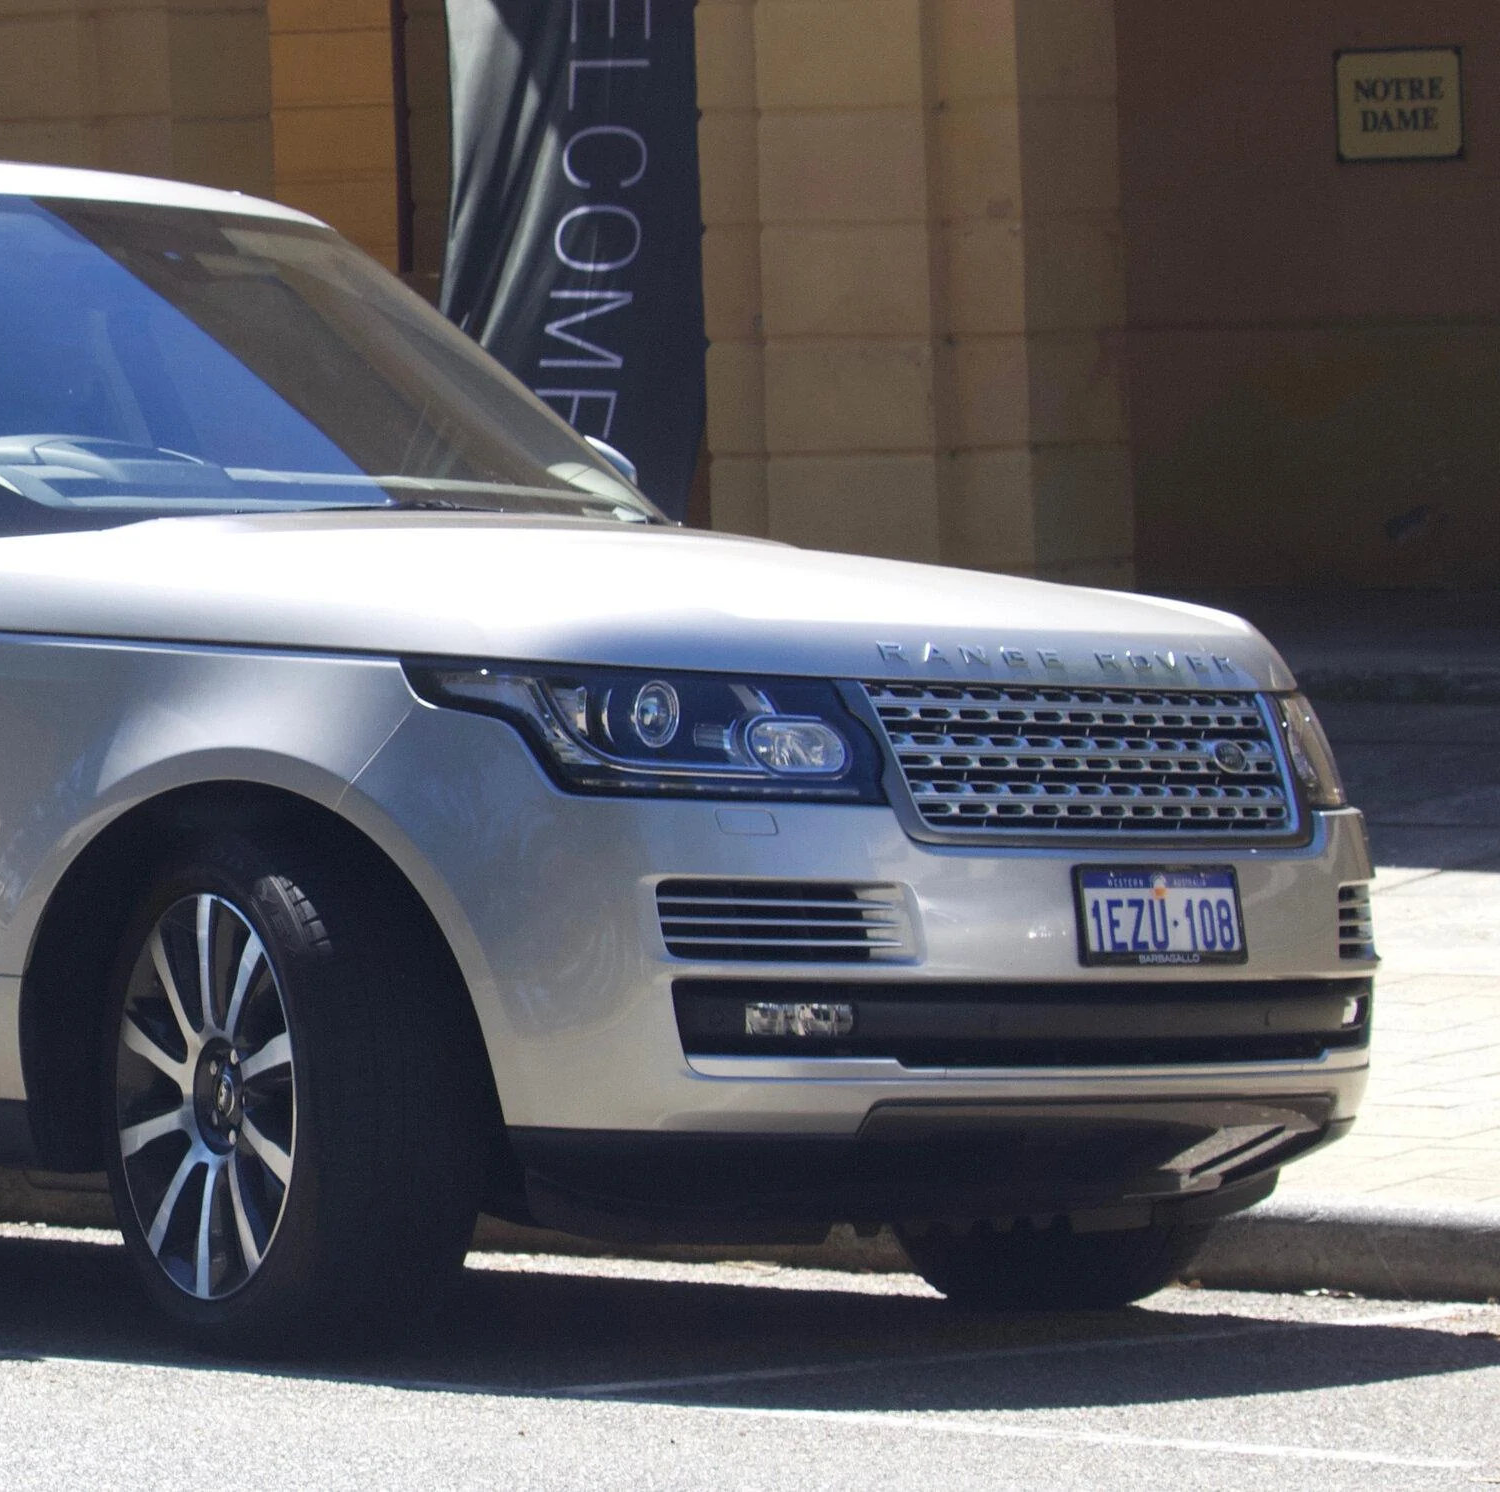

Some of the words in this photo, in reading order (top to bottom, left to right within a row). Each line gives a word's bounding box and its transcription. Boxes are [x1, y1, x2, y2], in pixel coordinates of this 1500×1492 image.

[1353, 76, 1445, 102] NOTRE
[1359, 107, 1440, 133] DAME
[875, 640, 1066, 668] RANGE
[1093, 649, 1236, 674] ROVER
[1107, 878, 1145, 888] WESTERN
